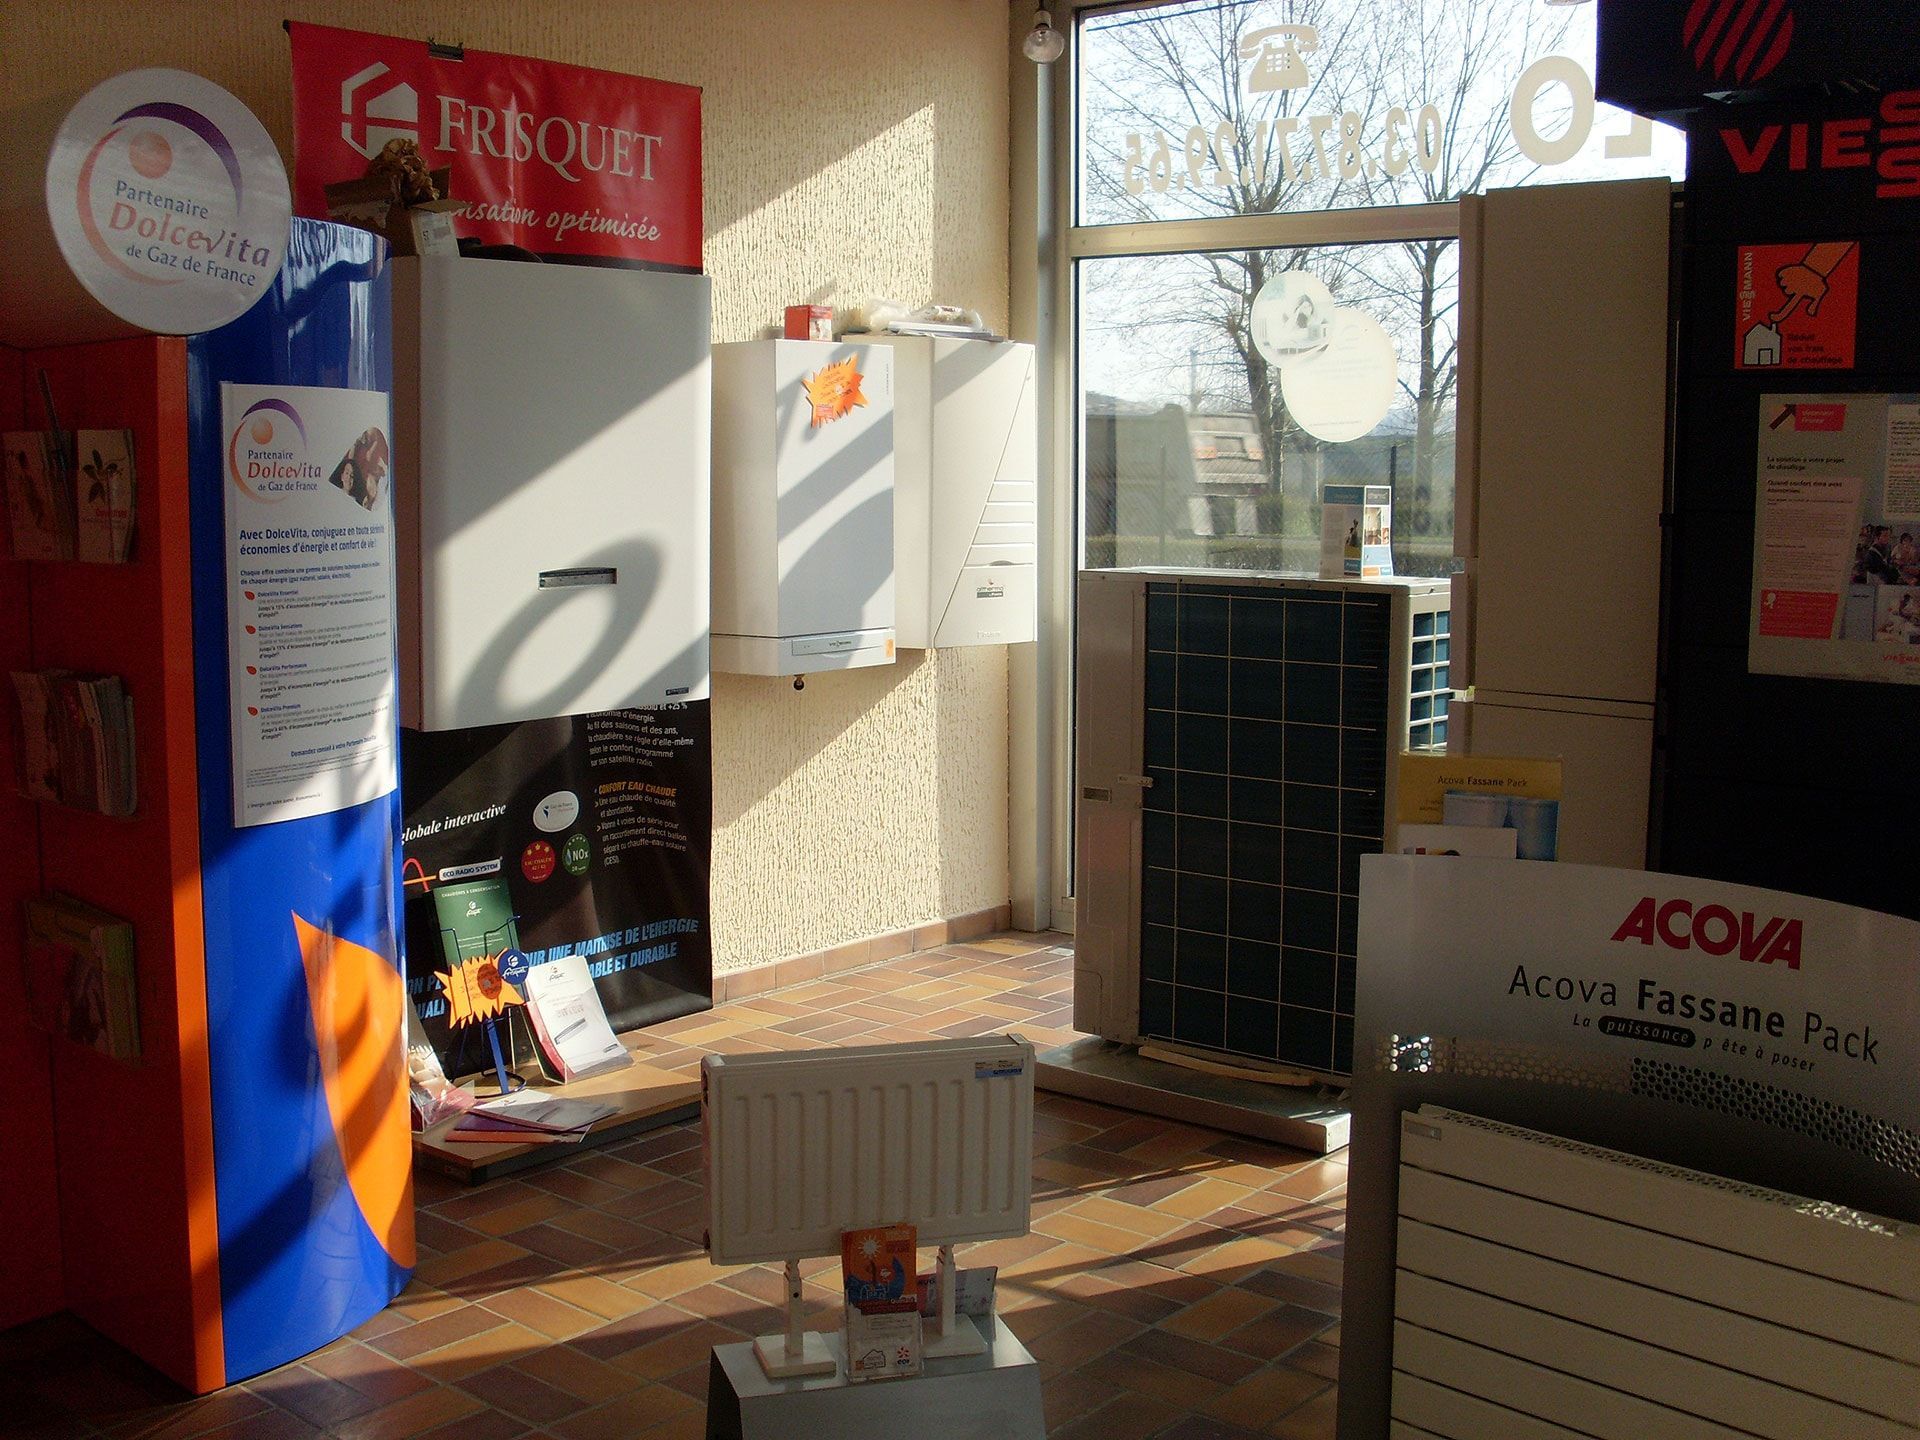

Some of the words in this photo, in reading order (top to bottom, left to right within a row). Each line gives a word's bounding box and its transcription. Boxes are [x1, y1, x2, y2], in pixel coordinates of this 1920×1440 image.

[434, 94, 662, 183] FRISQUET
[116, 180, 209, 219] Partenaire
[546, 208, 662, 241] optimisée
[127, 245, 142, 258] de
[148, 246, 177, 268] Gaz
[182, 256, 201, 273] de
[206, 260, 256, 287] France
[248, 450, 294, 460] Partenaire
[268, 481, 283, 491] Gaz
[285, 482, 294, 491] de
[296, 481, 318, 491] France
[240, 529, 263, 540] Avec
[266, 529, 309, 540] DolceVita,
[312, 528, 346, 539] conjuguez
[240, 543, 290, 555] économies
[293, 542, 329, 554] d'énergie
[339, 541, 360, 550] confort
[601, 720, 613, 729] des
[615, 721, 640, 732] saisons
[650, 727, 662, 735] des
[664, 727, 678, 736] ans,
[610, 744, 634, 753] confort
[628, 782, 644, 791] EAU
[645, 782, 677, 797] CHAUDE
[1437, 776, 1464, 786] Acova
[1467, 777, 1504, 787] Fassane
[1507, 778, 1528, 788] Pack
[444, 804, 507, 830] interactive
[573, 849, 588, 862] NOx
[455, 868, 474, 876] RADIO
[475, 864, 498, 873] SYSTEM
[625, 927, 640, 945] DE
[1610, 897, 1803, 970] ACOVA
[615, 954, 628, 973] ET
[630, 942, 678, 968] DURABLE
[1508, 965, 1617, 1007] Acova
[1637, 979, 1784, 1037] Fassane
[1804, 1011, 1879, 1064] Pack
[1573, 1014, 1590, 1028] La
[1606, 1019, 1689, 1045] puissance
[1755, 1045, 1763, 1059] à
[1771, 1052, 1816, 1073] poser
